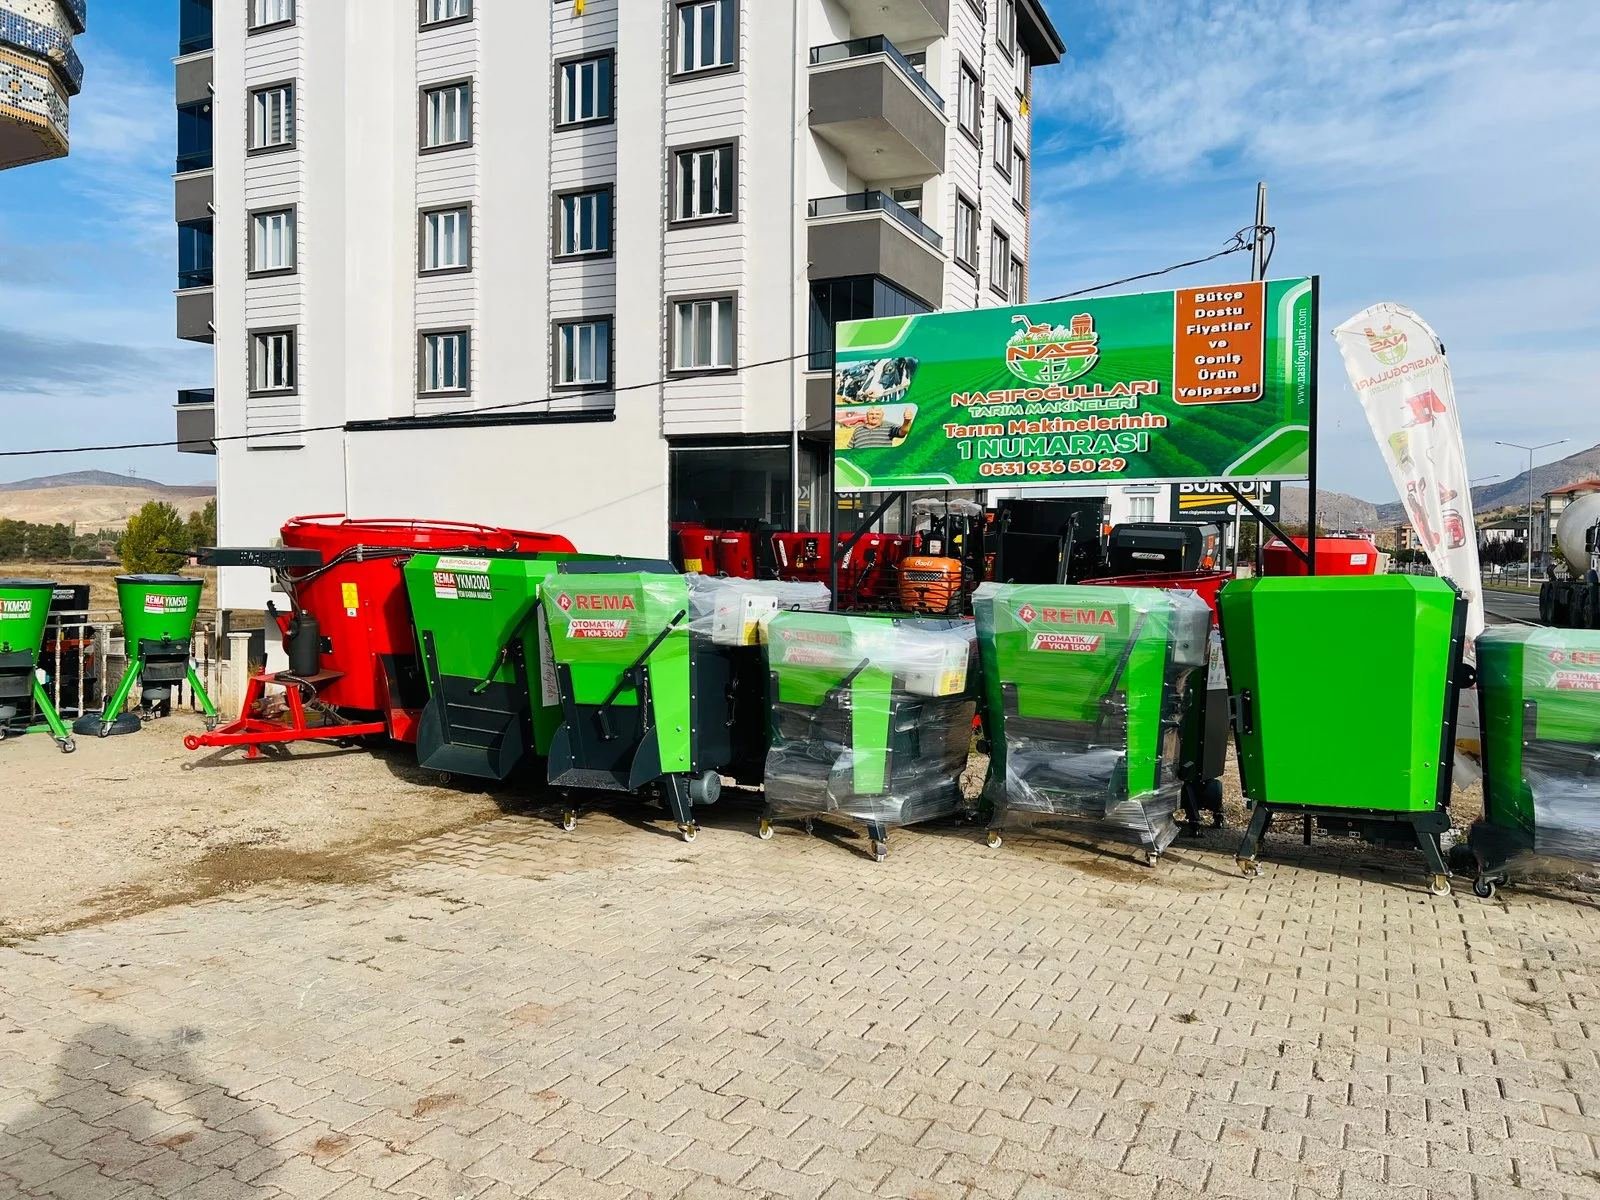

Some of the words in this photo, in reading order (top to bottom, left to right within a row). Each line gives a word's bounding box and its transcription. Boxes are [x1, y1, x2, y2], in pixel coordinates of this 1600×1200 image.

[1194, 290, 1244, 303] Bütçe
[1194, 306, 1243, 319] Dostu
[1186, 322, 1252, 335] Fiyatlar
[1007, 339, 1098, 362] NAS
[1208, 340, 1228, 349] ve
[1194, 353, 1242, 365] Geniş
[1295, 307, 1309, 405] www.nasifogullari.com
[1197, 369, 1237, 381] Ürün
[951, 380, 1159, 407] NASIFOĞULLARI
[1178, 383, 1258, 398] Yelpazesi
[969, 405, 1024, 418] TARIM
[1025, 396, 1138, 415] MAKİNELERİ
[943, 423, 1003, 438] Tarım
[1008, 413, 1167, 436] Makinelerinin
[957, 440, 971, 460] 1
[978, 431, 1150, 459] NUMARASI
[980, 461, 1025, 477] 0531
[1027, 460, 1065, 475] 936
[1068, 458, 1096, 474] 50
[1098, 457, 1126, 473] 29
[433, 573, 455, 585] REMA
[456, 574, 490, 589] YKM2000
[3, 600, 32, 612] YKM500
[145, 594, 164, 604] REMA
[164, 596, 188, 607] YKM500
[576, 595, 635, 610] REMA
[1042, 608, 1115, 625] REMA
[583, 629, 600, 637] YKM
[602, 630, 624, 638] 3000
[1071, 643, 1091, 651] 1500
